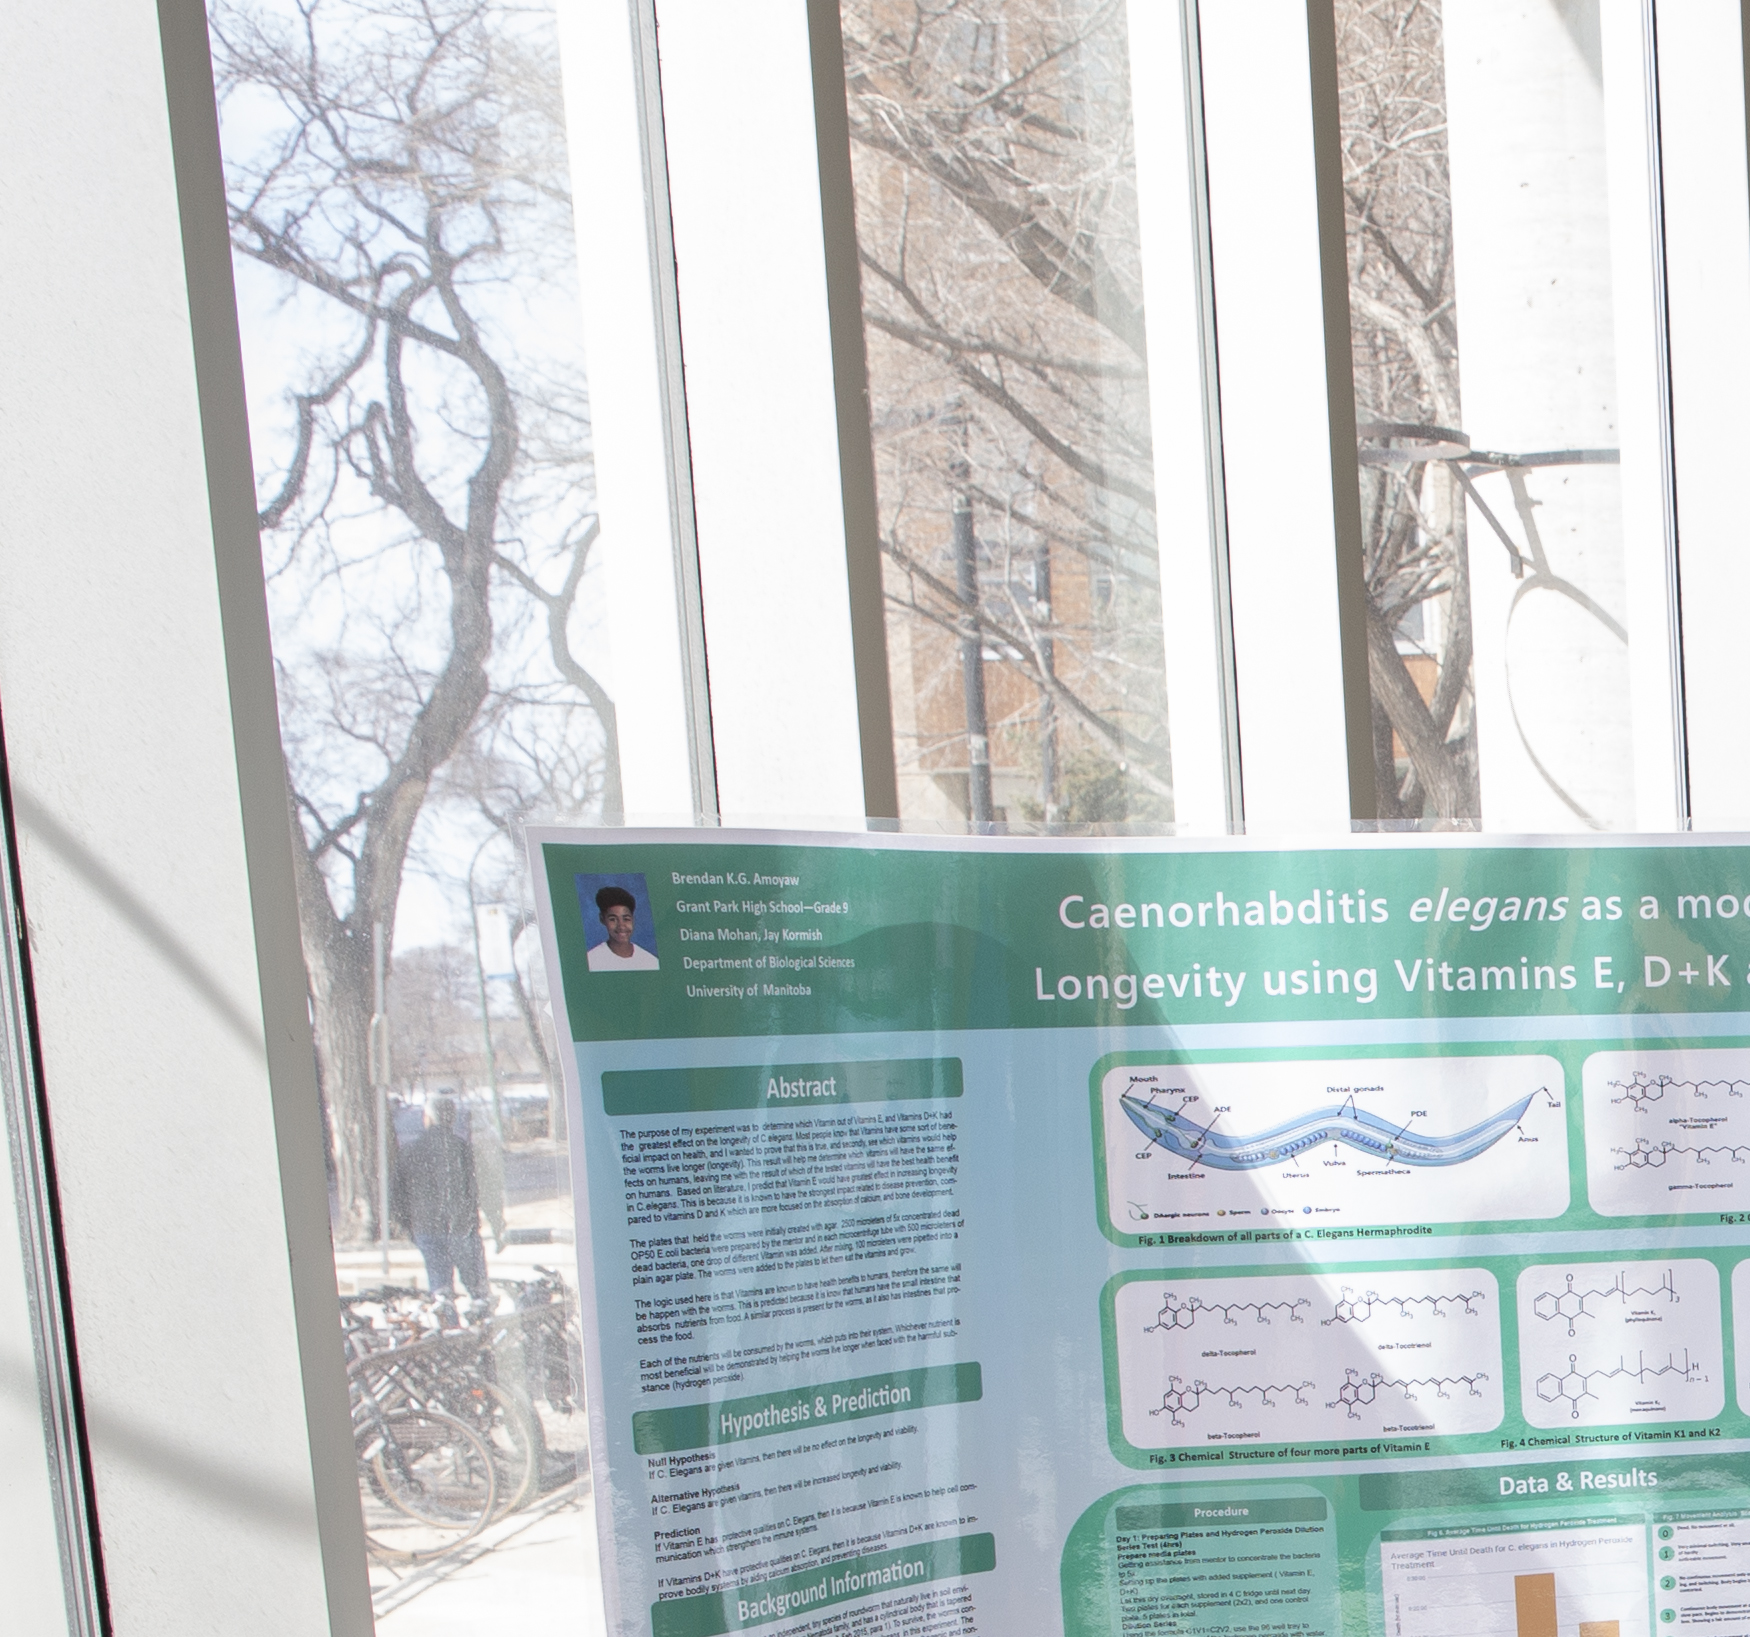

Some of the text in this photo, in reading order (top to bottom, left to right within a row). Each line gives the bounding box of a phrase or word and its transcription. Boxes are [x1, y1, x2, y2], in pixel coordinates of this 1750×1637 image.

[671, 871, 723, 884] Brendan
[753, 872, 799, 887] Amoyaw
[676, 900, 710, 912] Grant
[713, 900, 739, 912] Park
[742, 900, 766, 915] High
[842, 901, 848, 913] 9
[1059, 889, 1388, 928] Caenorhabditis
[1410, 887, 1569, 930] elegans
[1581, 896, 1622, 920] as
[1639, 896, 1658, 919] a
[680, 928, 822, 942] Diana Mohan, Jay Kormish
[683, 955, 855, 971] Department of Biological Sciences
[686, 983, 811, 999] University of Manitoba
[1036, 963, 1246, 1008] Longevity
[1263, 960, 1377, 1003] using
[1394, 956, 1576, 991] Vitamins
[1594, 956, 1624, 992] E,
[1644, 954, 1730, 987] D+K
[766, 1076, 836, 1098] Abstract
[1720, 1214, 1736, 1224] Fig.
[1739, 1213, 1745, 1221] 2
[1138, 1235, 1156, 1246] Fig.
[1159, 1235, 1165, 1244] 1
[1167, 1233, 1224, 1243] Breakdown
[1227, 1231, 1237, 1241] of
[1240, 1231, 1252, 1240] all
[1254, 1231, 1282, 1242] parts
[1283, 1229, 1293, 1240] of
[1304, 1230, 1313, 1238] C.
[1316, 1229, 1354, 1239] Elegans
[1357, 1225, 1432, 1237] Hermaphrodite
[721, 1385, 911, 1436] Hypothesis & Prediction
[1500, 1428, 1720, 1449] Fig. 4 Chemical Structure of Vitamin K1 and K2
[647, 1453, 715, 1467] Null Hypothesis
[1149, 1454, 1167, 1465] Fig.
[1169, 1453, 1175, 1462] 3
[1178, 1450, 1223, 1461] Chemical
[1228, 1450, 1274, 1459] Structure
[1277, 1447, 1287, 1457] of
[1290, 1447, 1310, 1456] four
[1342, 1446, 1367, 1456] parts
[1370, 1443, 1380, 1453] of
[1382, 1442, 1421, 1452] Vitamin
[1424, 1442, 1430, 1450] E
[1500, 1468, 1657, 1494] Data & Results
[651, 1483, 740, 1503] Alternative Hypothesis
[1194, 1506, 1248, 1517] Procedure
[654, 1527, 701, 1540] Prediction
[737, 1560, 924, 1621] Background Information
